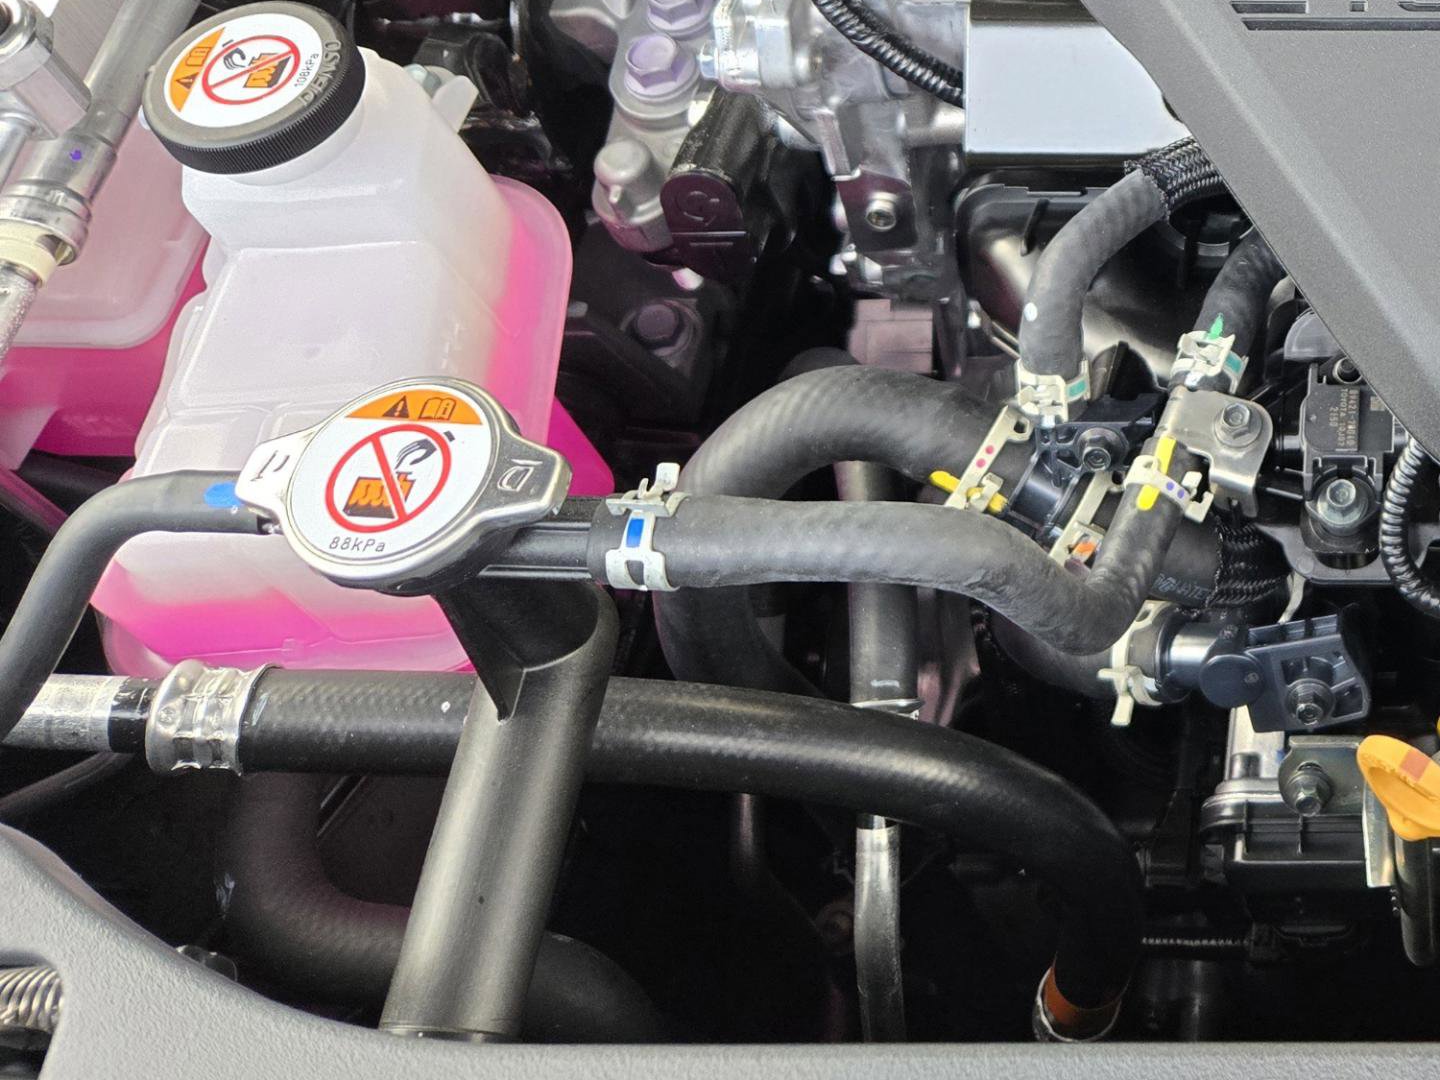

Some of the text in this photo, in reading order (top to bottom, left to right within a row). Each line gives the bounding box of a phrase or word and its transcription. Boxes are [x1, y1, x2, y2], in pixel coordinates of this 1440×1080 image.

[294, 52, 319, 87] 108kPa
[300, 40, 341, 107] DENSO
[329, 536, 385, 552] 88kPa
